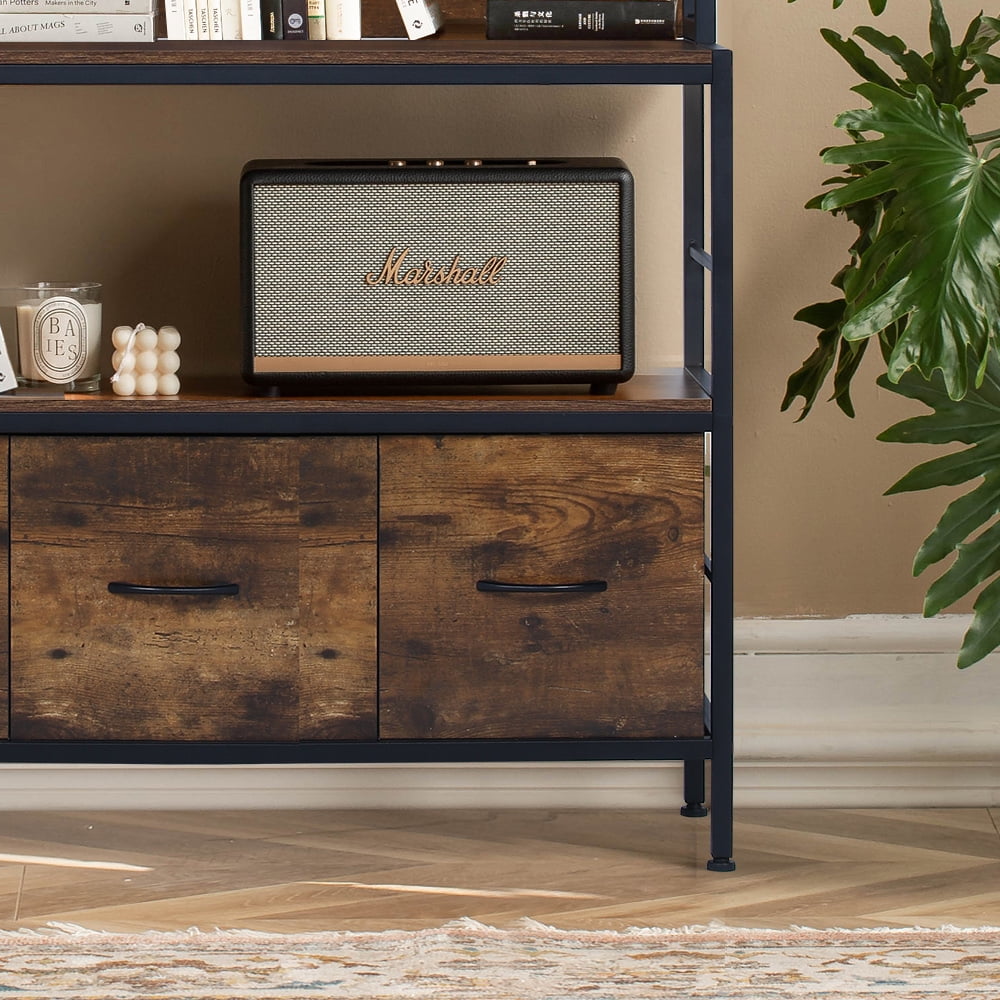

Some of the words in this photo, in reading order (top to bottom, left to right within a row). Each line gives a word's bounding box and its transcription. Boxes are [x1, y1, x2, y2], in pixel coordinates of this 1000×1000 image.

[84, 0, 97, 8] City
[9, 24, 38, 34] ABOUT
[40, 20, 65, 31] MAGS
[365, 247, 508, 285] Marshall
